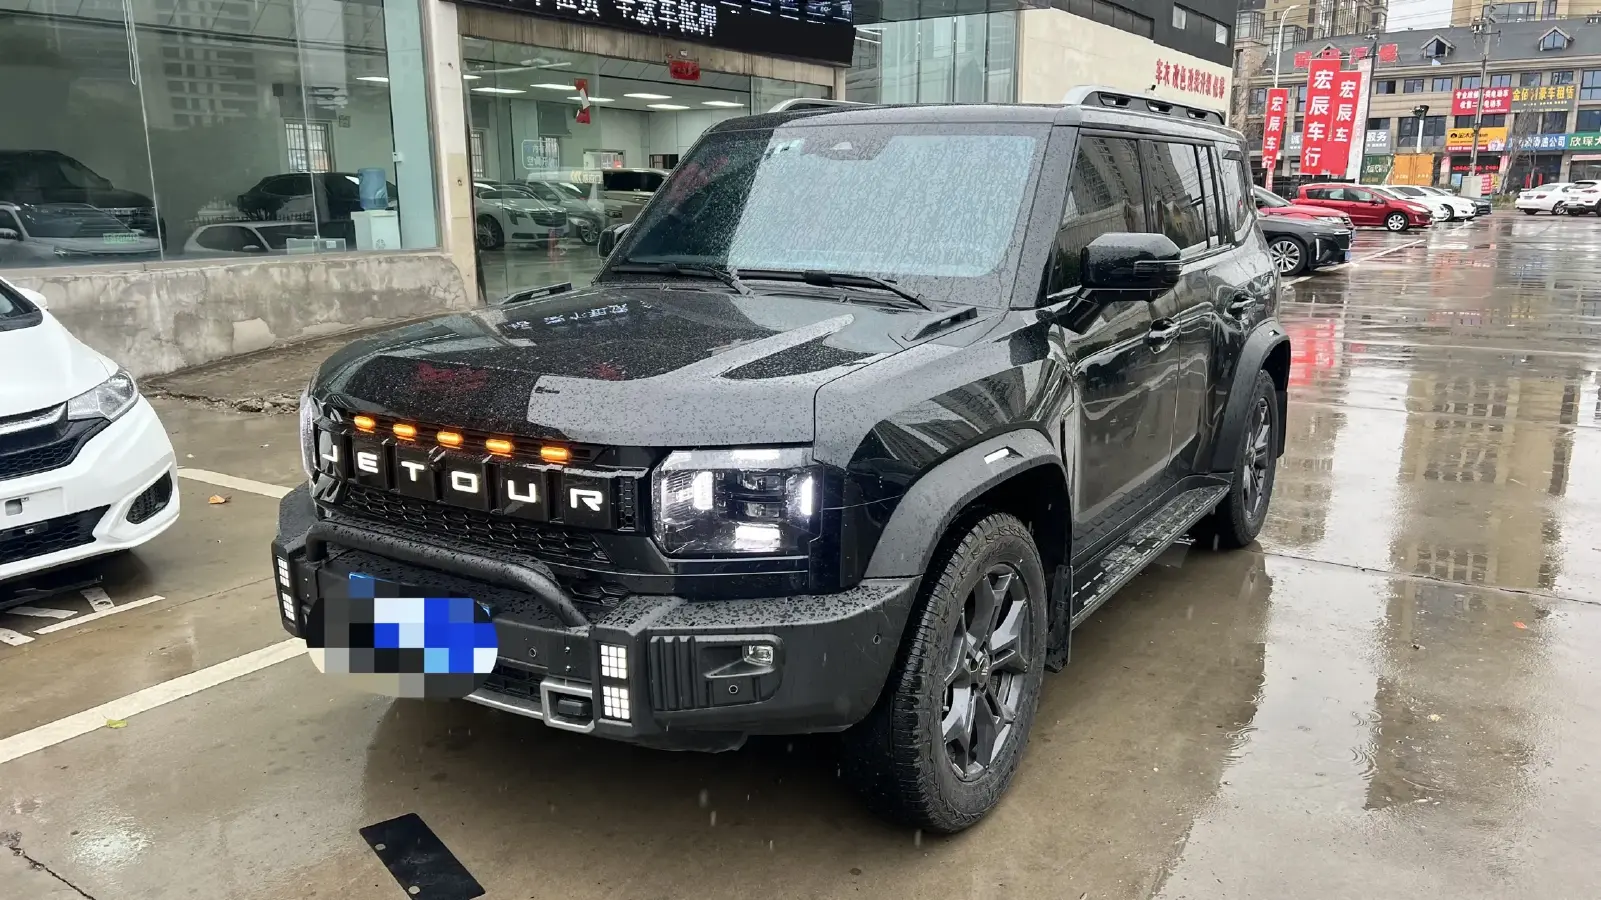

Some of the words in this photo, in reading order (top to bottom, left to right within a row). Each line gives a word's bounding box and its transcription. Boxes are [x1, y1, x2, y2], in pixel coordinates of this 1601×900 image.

[1262, 96, 1284, 168] 宏辰车行
[1305, 70, 1334, 167] 宏辰车行
[322, 445, 603, 511] JETOUR
